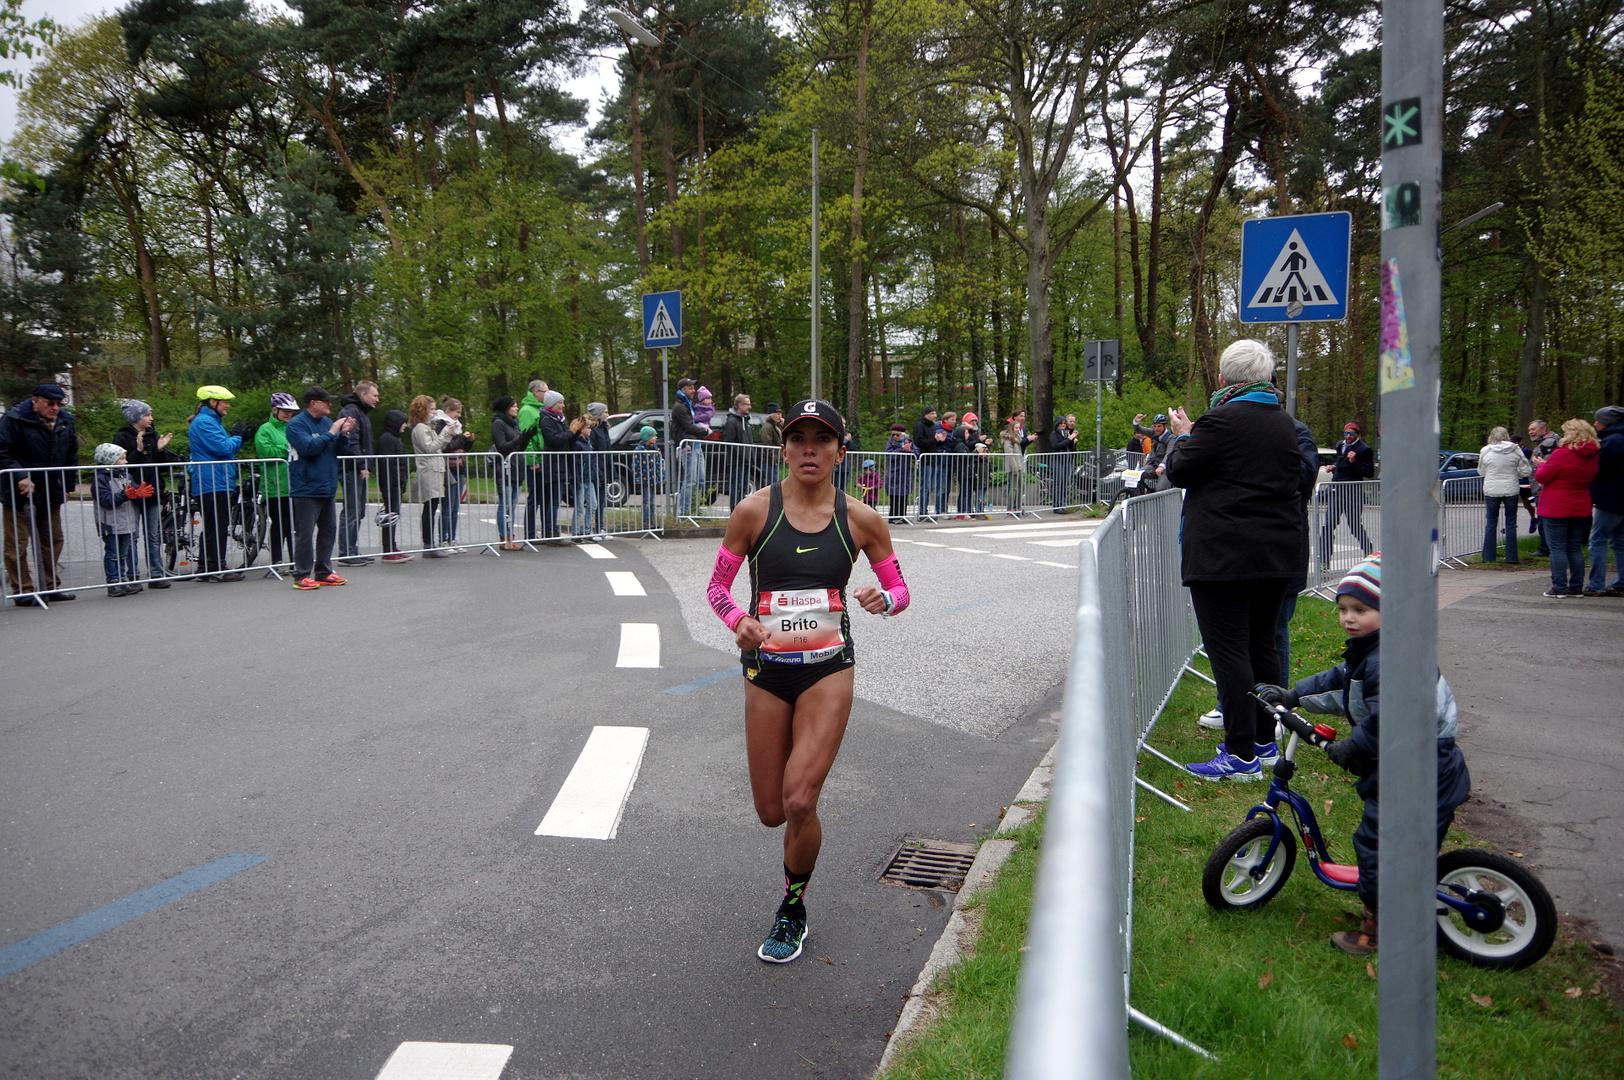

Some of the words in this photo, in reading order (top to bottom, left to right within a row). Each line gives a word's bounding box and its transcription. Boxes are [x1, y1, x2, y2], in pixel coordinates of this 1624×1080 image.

[791, 596, 822, 607] Haspa
[781, 618, 818, 632] Brito
[793, 636, 808, 644] F16
[810, 648, 835, 660] Mobil
